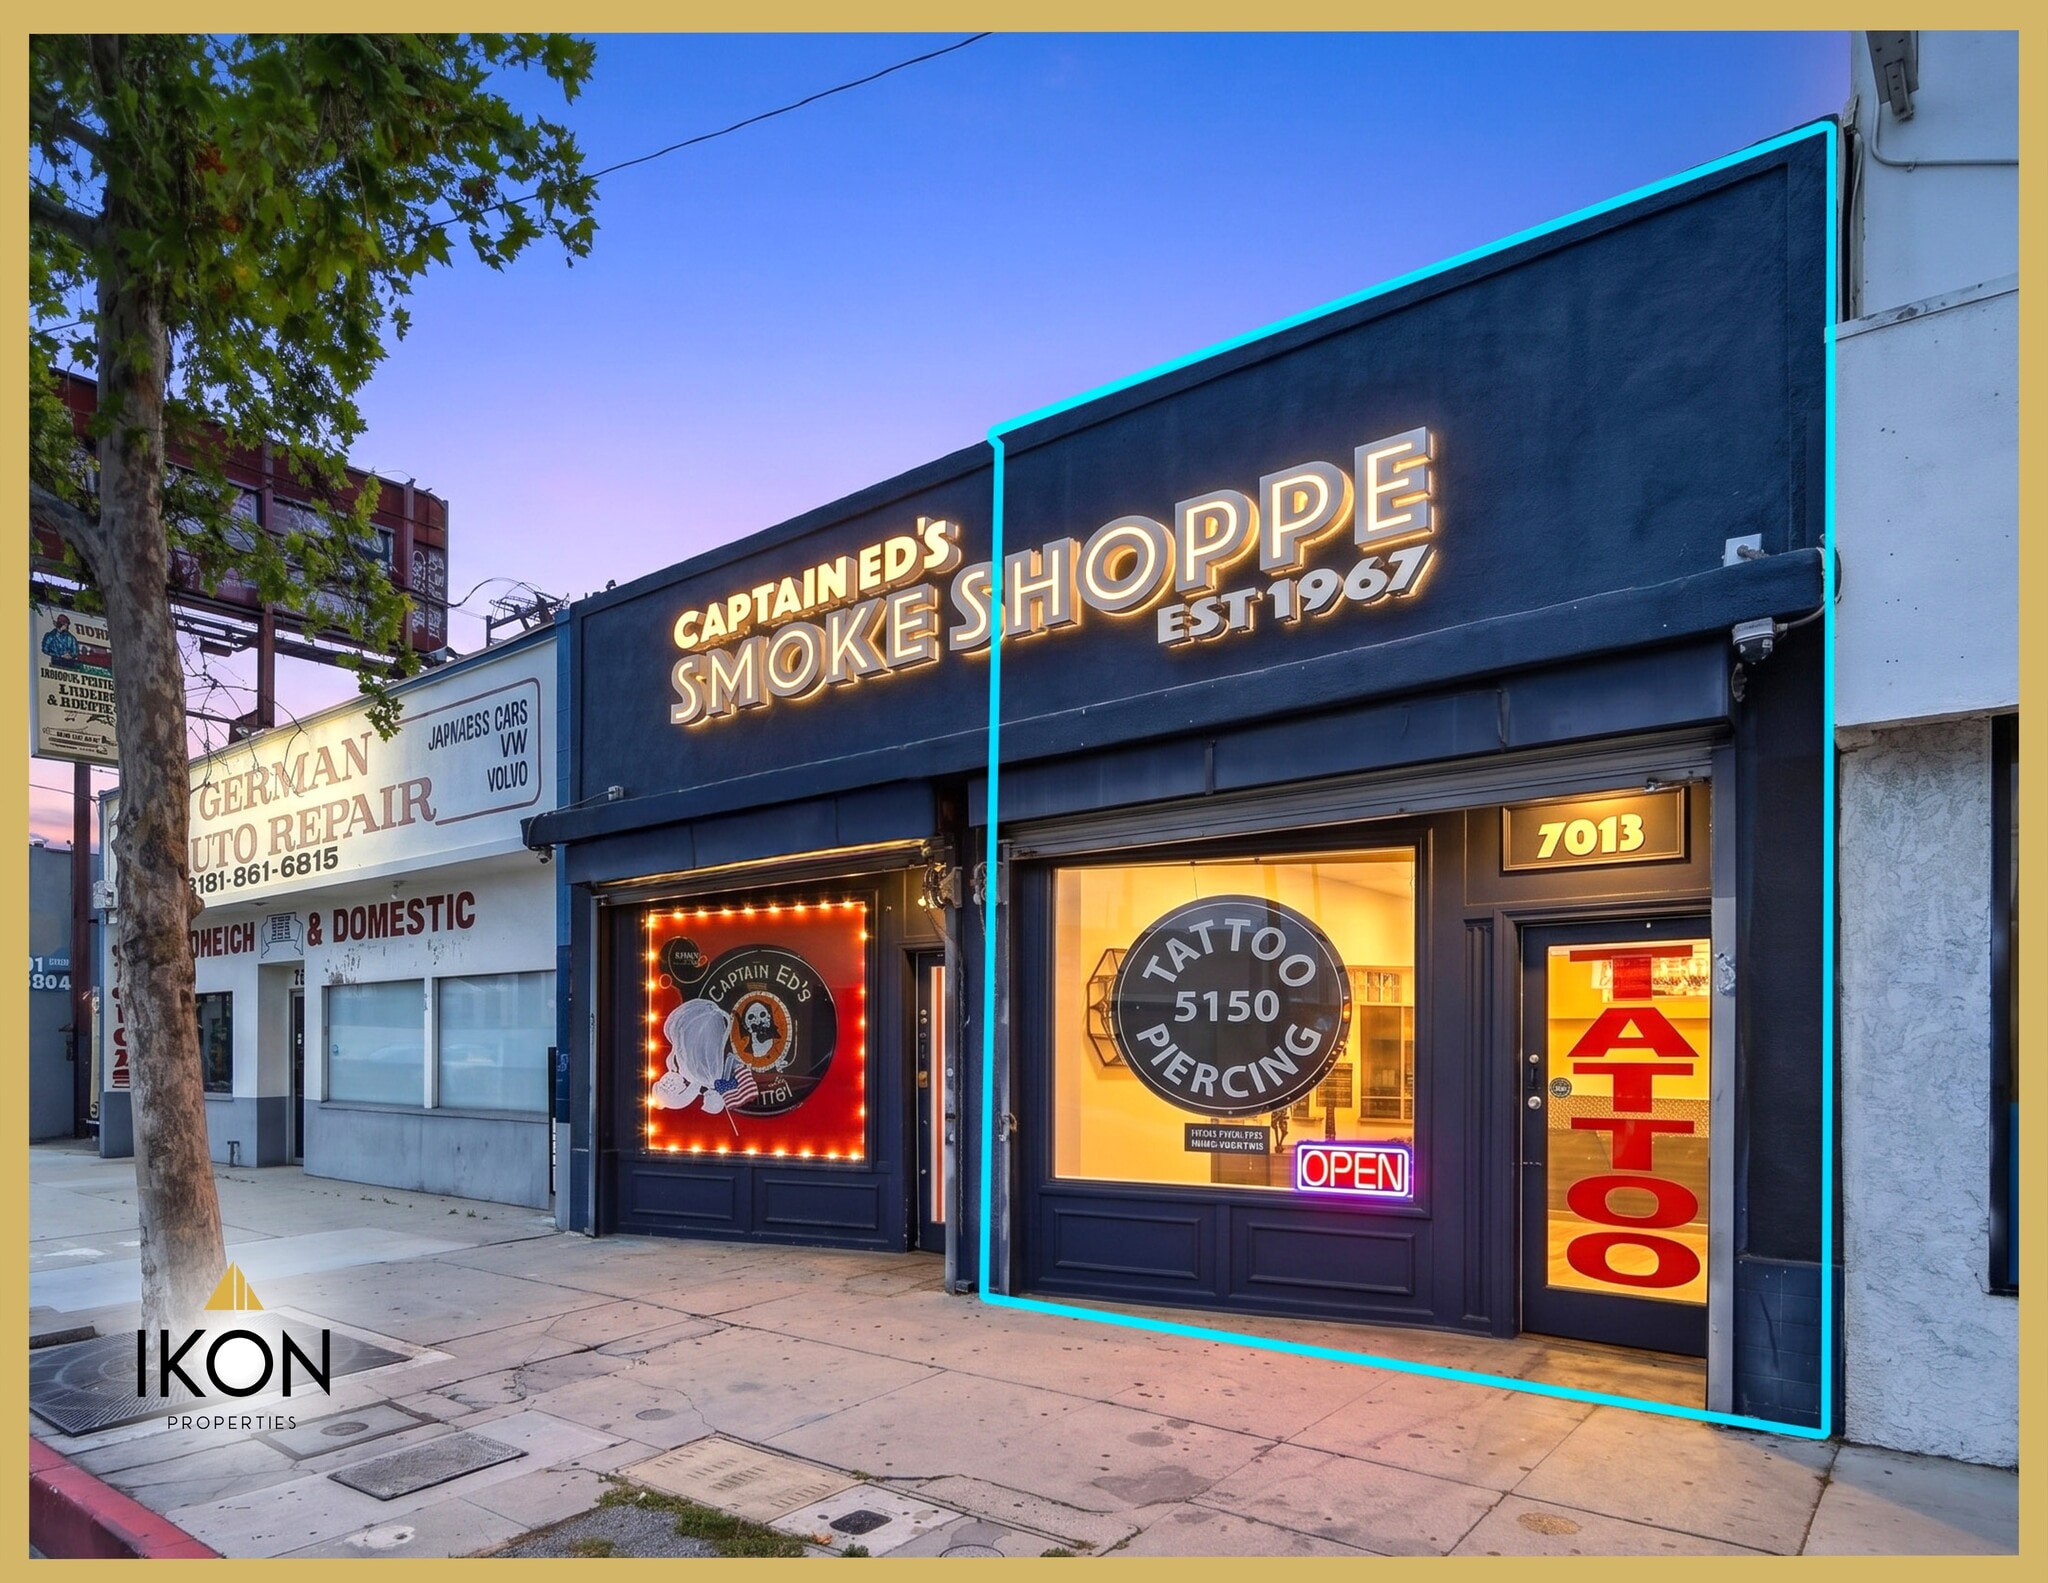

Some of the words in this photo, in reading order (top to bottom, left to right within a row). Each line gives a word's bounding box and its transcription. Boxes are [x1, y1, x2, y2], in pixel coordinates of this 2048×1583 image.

[671, 583, 938, 725] SMOKE
[949, 426, 1433, 656] SHOPPE
[673, 555, 852, 650] CAPTAIN
[859, 516, 957, 592] ED'S
[1158, 588, 1260, 646] EST
[1267, 543, 1432, 622] 1967
[428, 709, 490, 751] JAPNAESS
[494, 698, 528, 732] CARS
[500, 727, 528, 758] VW
[199, 731, 373, 821] GERMAN
[487, 760, 528, 792] VOLVO
[189, 823, 258, 874] UTO
[268, 776, 437, 856] REPAIR
[1537, 813, 1646, 859] 7013
[307, 912, 323, 947] &
[333, 890, 476, 943] DOMESTIC
[708, 964, 770, 1003] CAPTAIN
[775, 964, 811, 1003] ED'S
[1142, 917, 1316, 988] TATTOO
[1174, 989, 1280, 1023] 5150
[1136, 1023, 1322, 1099] PIERCING
[1566, 944, 1701, 1289] TATTOO
[1301, 1149, 1403, 1191] OPEN
